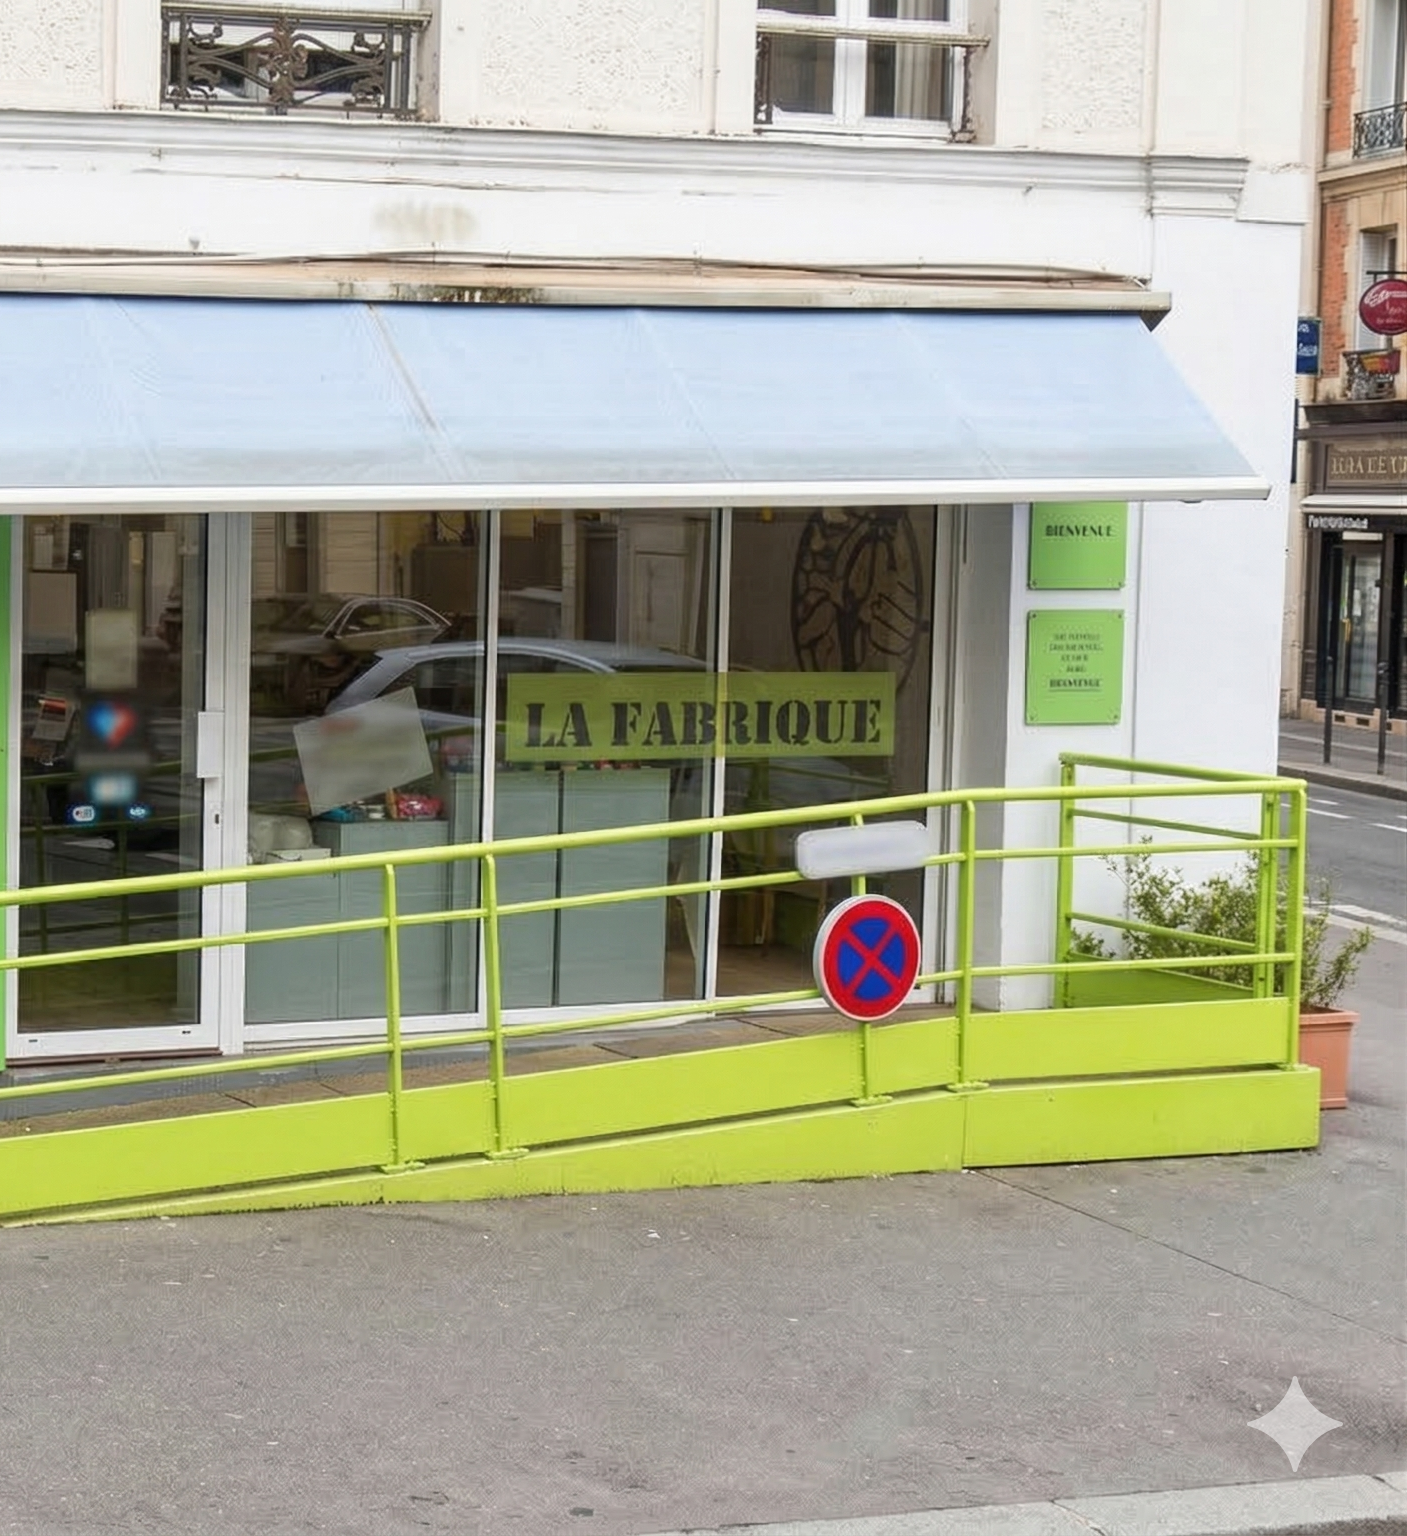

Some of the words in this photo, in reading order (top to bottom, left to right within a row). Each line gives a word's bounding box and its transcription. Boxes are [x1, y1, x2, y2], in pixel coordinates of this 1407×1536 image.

[1045, 524, 1113, 537] BIENVENUE
[524, 700, 593, 748] LA
[609, 698, 883, 748] FABRIQUE
